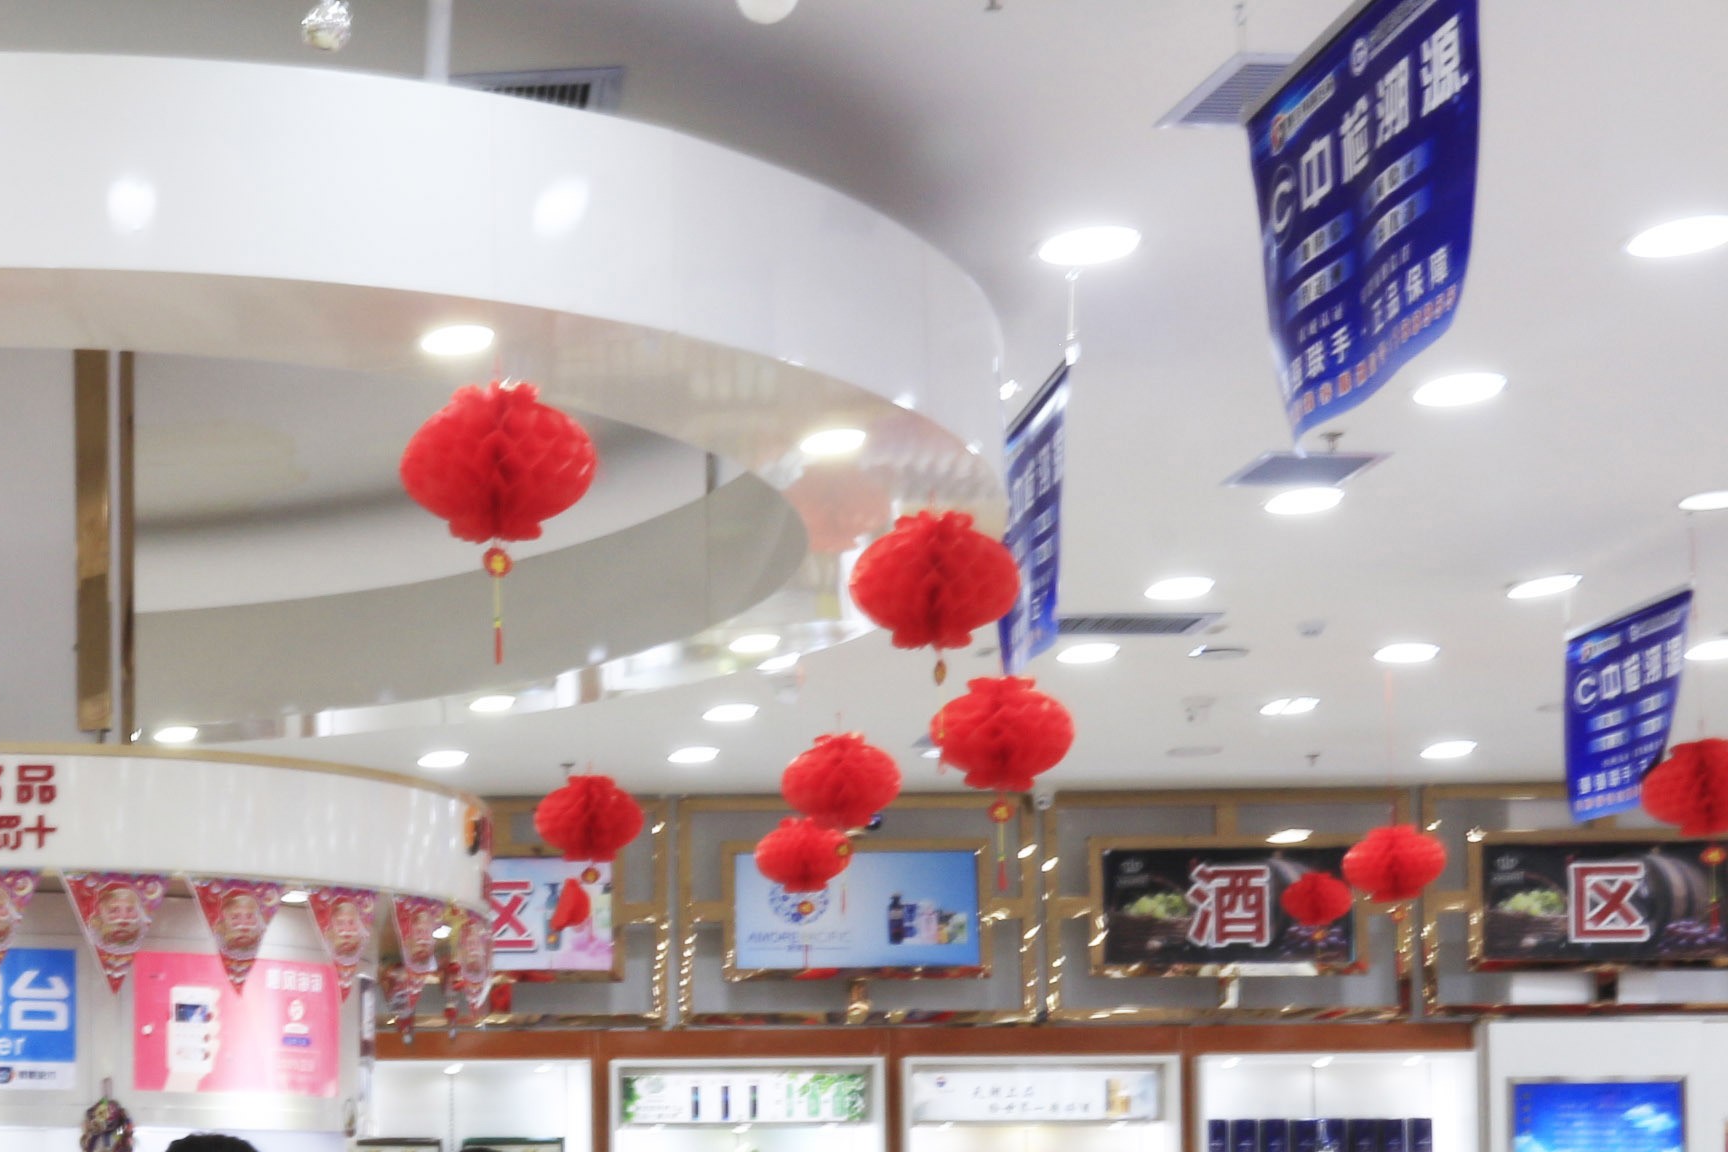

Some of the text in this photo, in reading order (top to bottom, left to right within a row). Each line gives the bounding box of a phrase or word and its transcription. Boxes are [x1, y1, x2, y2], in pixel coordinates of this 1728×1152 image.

[1298, 12, 1471, 213] 中检溯源
[1187, 862, 1271, 948] 酒
[1569, 861, 1651, 944] 区
